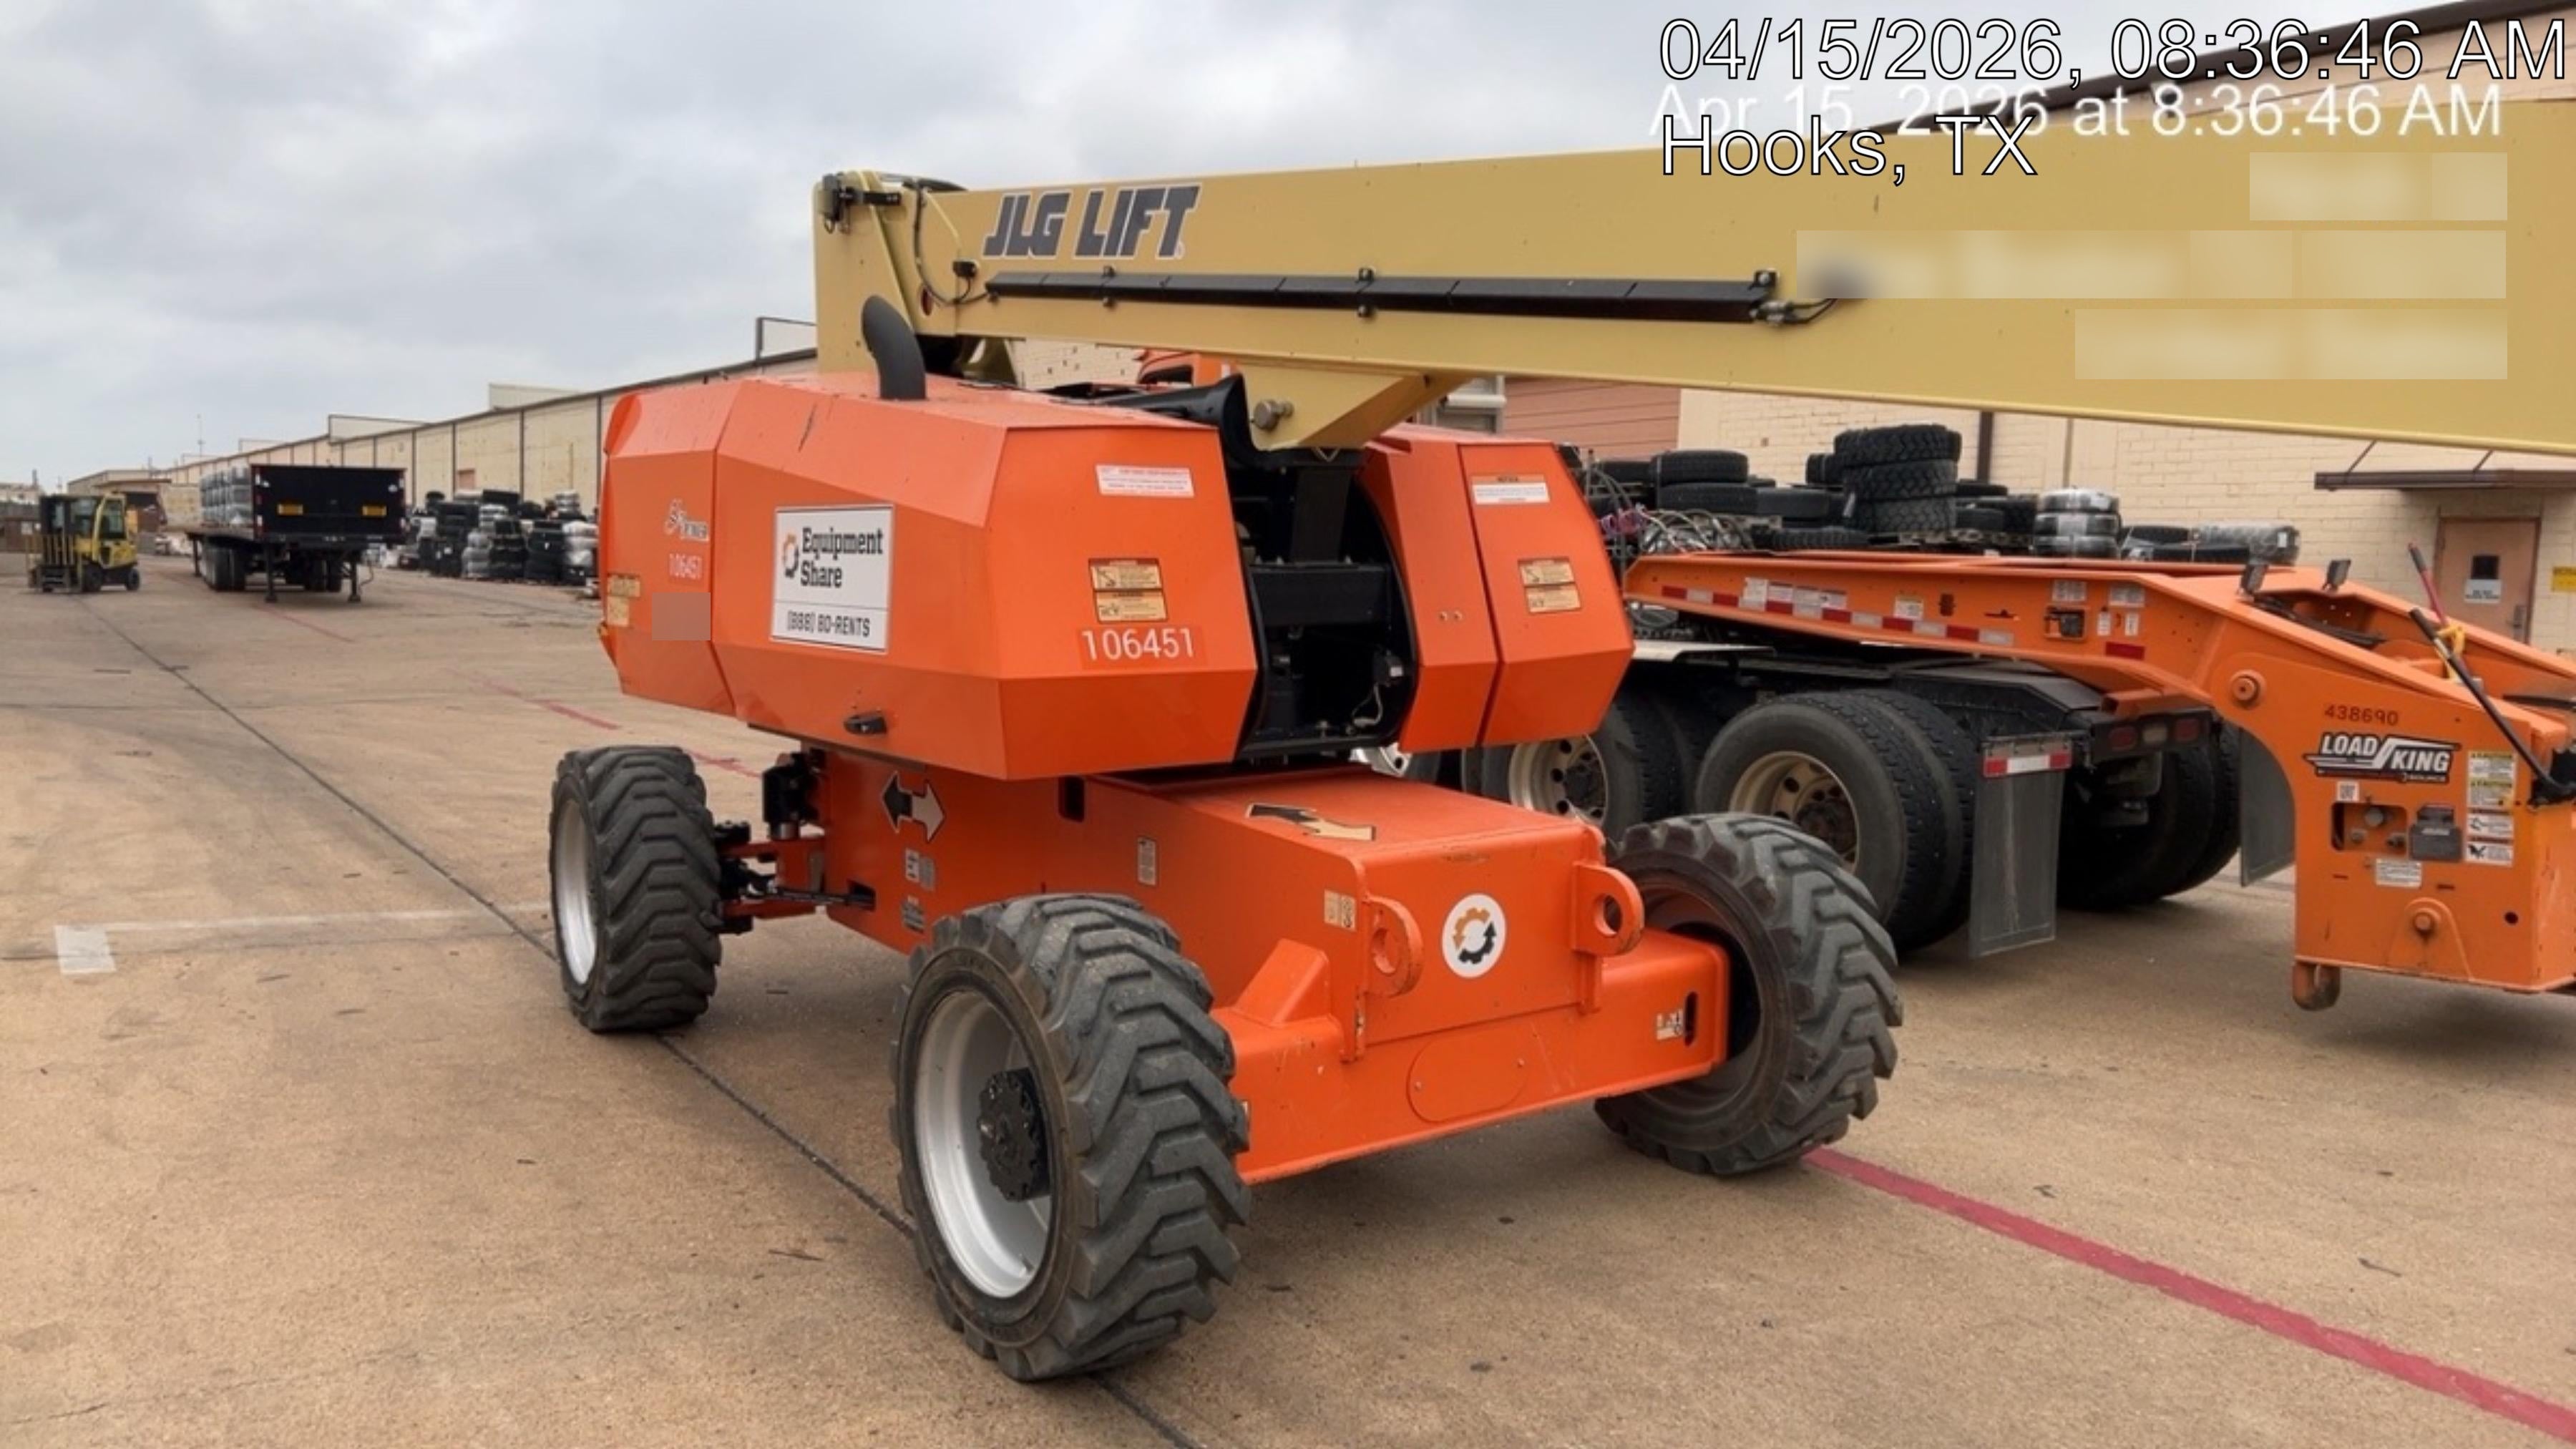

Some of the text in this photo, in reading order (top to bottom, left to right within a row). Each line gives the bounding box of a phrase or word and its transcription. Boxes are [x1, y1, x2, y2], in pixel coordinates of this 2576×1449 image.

[982, 185, 1201, 258] JLG LIFT
[801, 526, 884, 560] Equipment
[800, 560, 843, 588] Share
[1081, 627, 1194, 662] 106451
[2324, 703, 2399, 726] 438690
[2321, 734, 2379, 756] LOAD
[2390, 749, 2451, 773] KING
